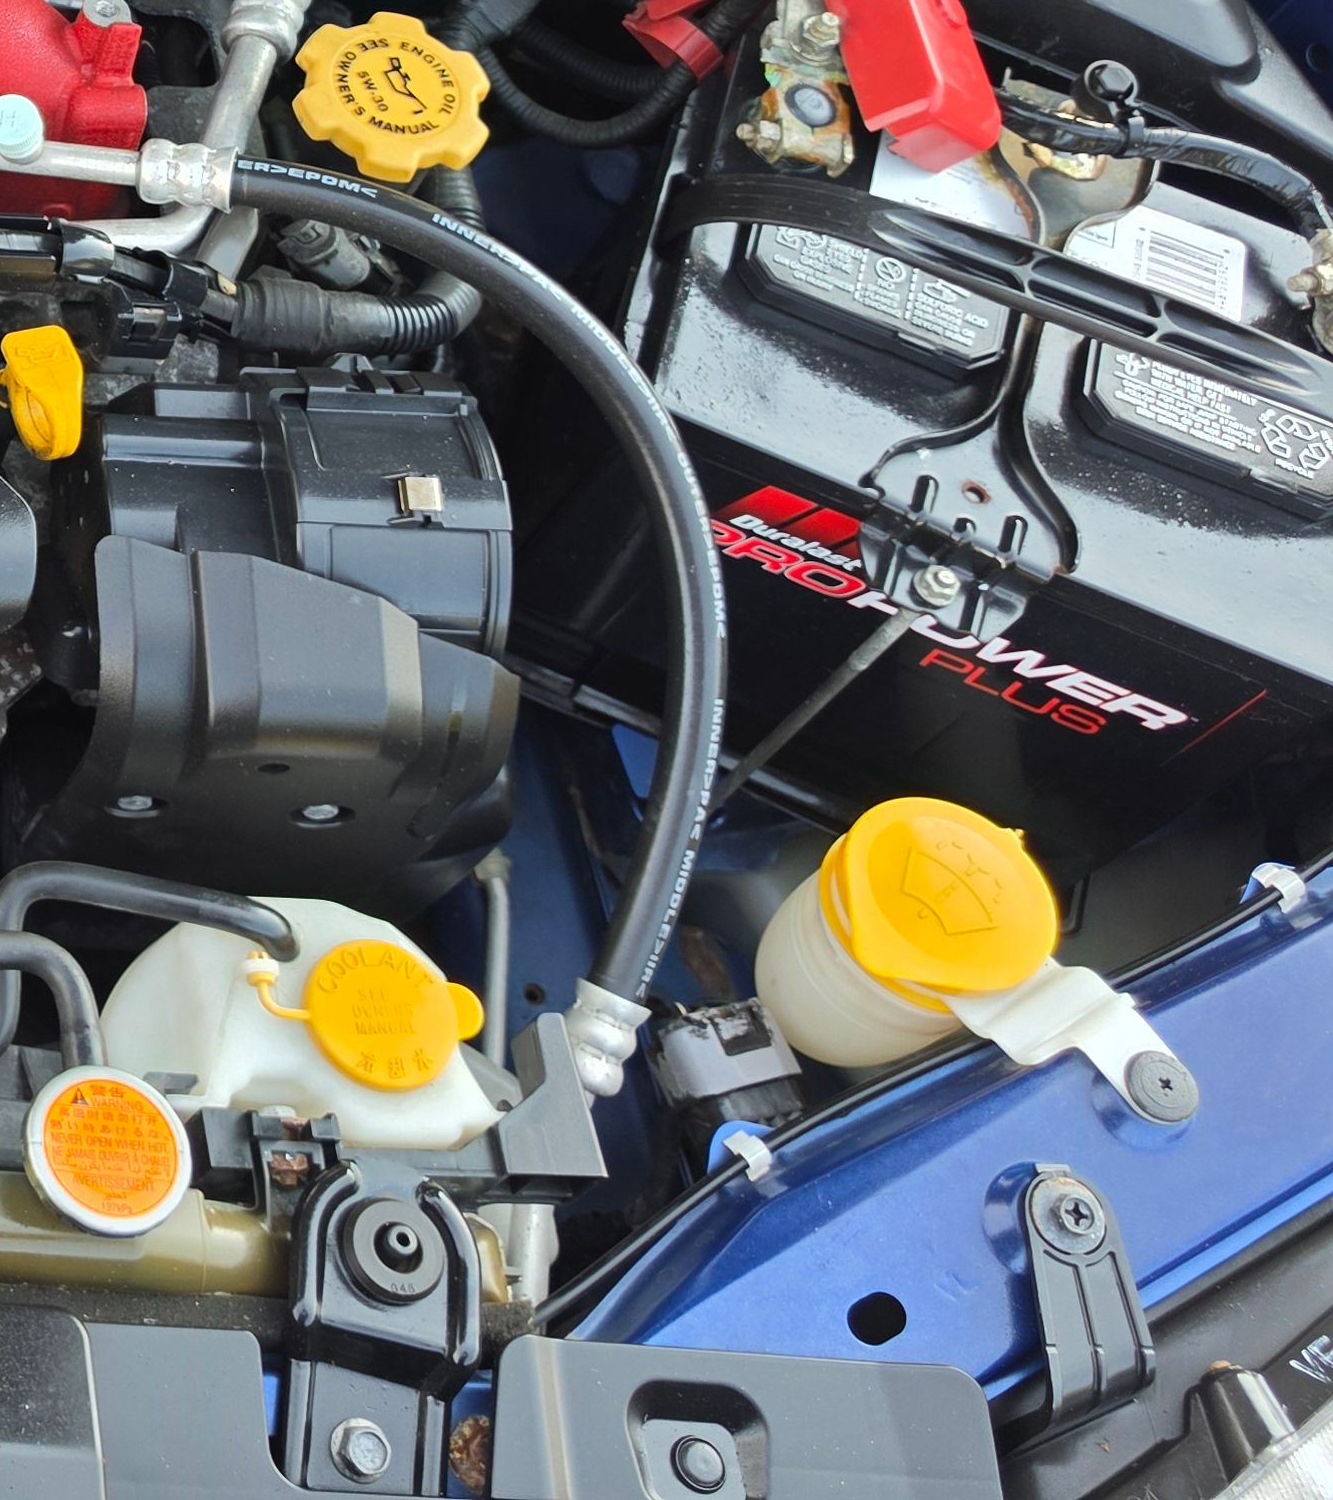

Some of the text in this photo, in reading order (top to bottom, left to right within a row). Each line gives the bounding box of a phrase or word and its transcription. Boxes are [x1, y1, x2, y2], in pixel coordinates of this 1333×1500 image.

[336, 38, 440, 135] SEE OWNER'S MANUAL
[357, 70, 389, 113] 5W-30
[400, 41, 457, 115] ENGINE OIL
[729, 513, 863, 572] Duralast
[919, 647, 1108, 736] PLUS
[317, 947, 434, 993] COOLANT
[354, 1020, 418, 1036] MANUAL
[91, 1097, 144, 1112] WARNING
[50, 1130, 83, 1145] NEVER
[85, 1134, 112, 1146] OPEN
[114, 1138, 145, 1151] WHEN
[72, 1171, 155, 1192] AVERTISSEMENT
